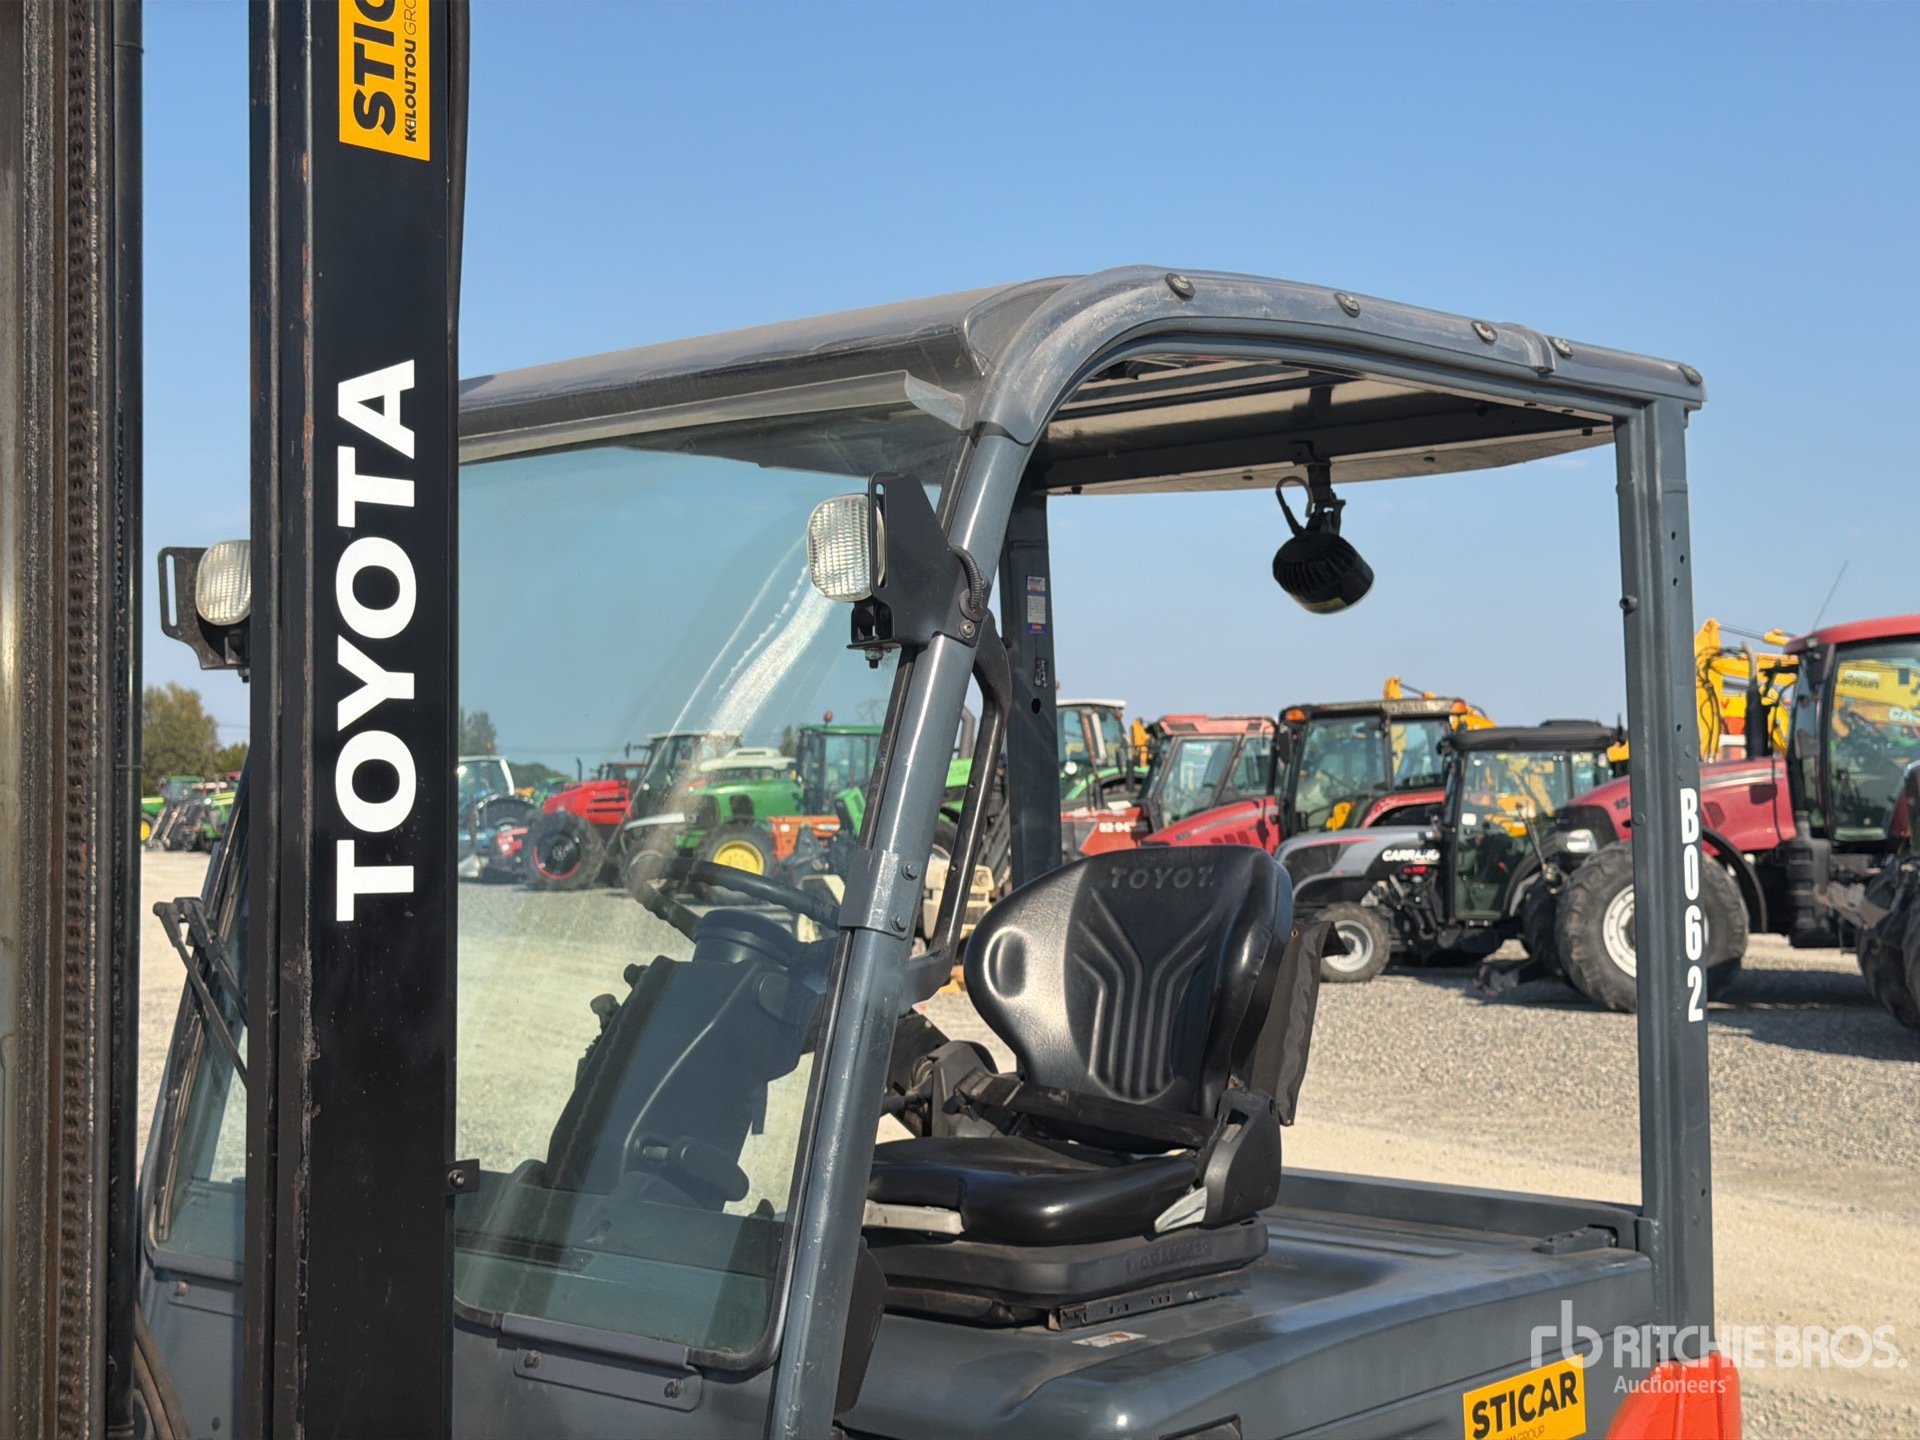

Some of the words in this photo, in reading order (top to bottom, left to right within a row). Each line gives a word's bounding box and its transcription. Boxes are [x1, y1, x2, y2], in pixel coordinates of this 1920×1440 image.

[334, 358, 418, 922] TOYOTA
[1111, 865, 1215, 889] TOYOT
[1680, 787, 1704, 1022] B062
[1471, 1370, 1578, 1439] STICAR
